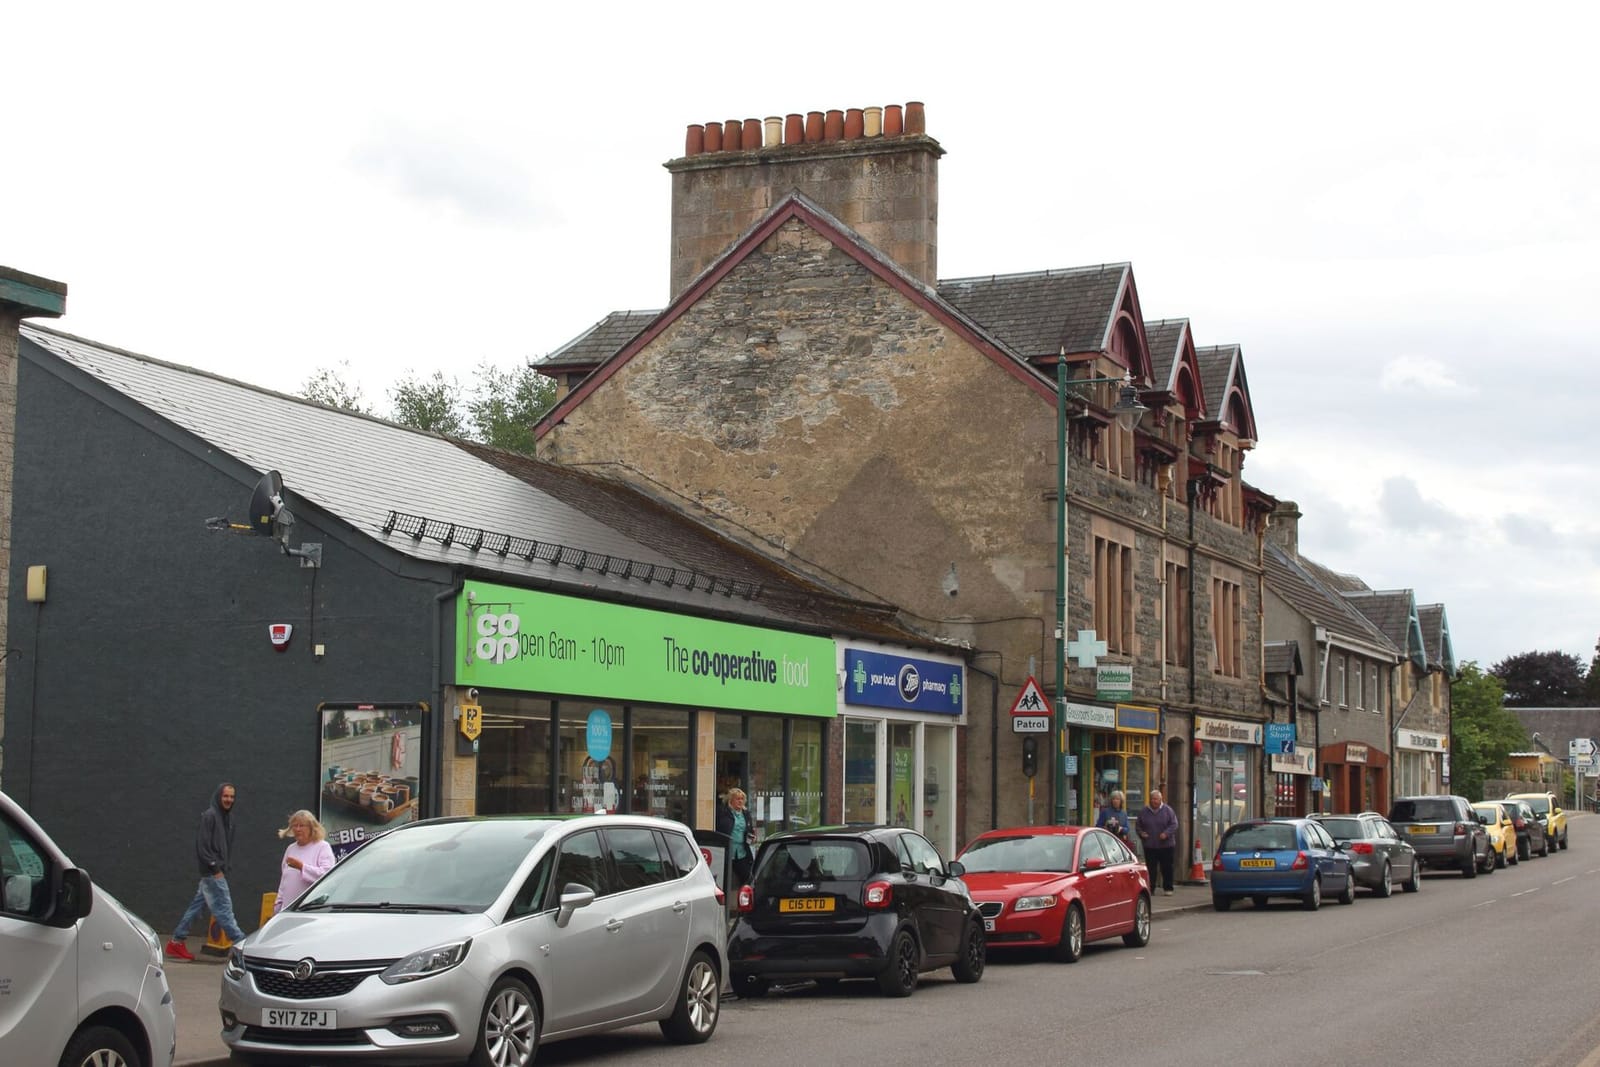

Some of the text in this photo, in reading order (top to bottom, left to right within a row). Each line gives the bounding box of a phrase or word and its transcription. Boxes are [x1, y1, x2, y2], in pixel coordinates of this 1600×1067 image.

[518, 631, 545, 661] pen
[550, 631, 577, 660] 6am
[592, 637, 625, 670] 10pm
[663, 636, 689, 674] The
[783, 654, 809, 688] food
[871, 673, 896, 686] your local
[922, 679, 946, 695] pharmacy
[1016, 720, 1046, 729] Patrol
[1270, 731, 1291, 740] Shop
[340, 827, 365, 844] BIG
[806, 899, 826, 909] CTD
[269, 1011, 328, 1026] SY17 ZPJ
